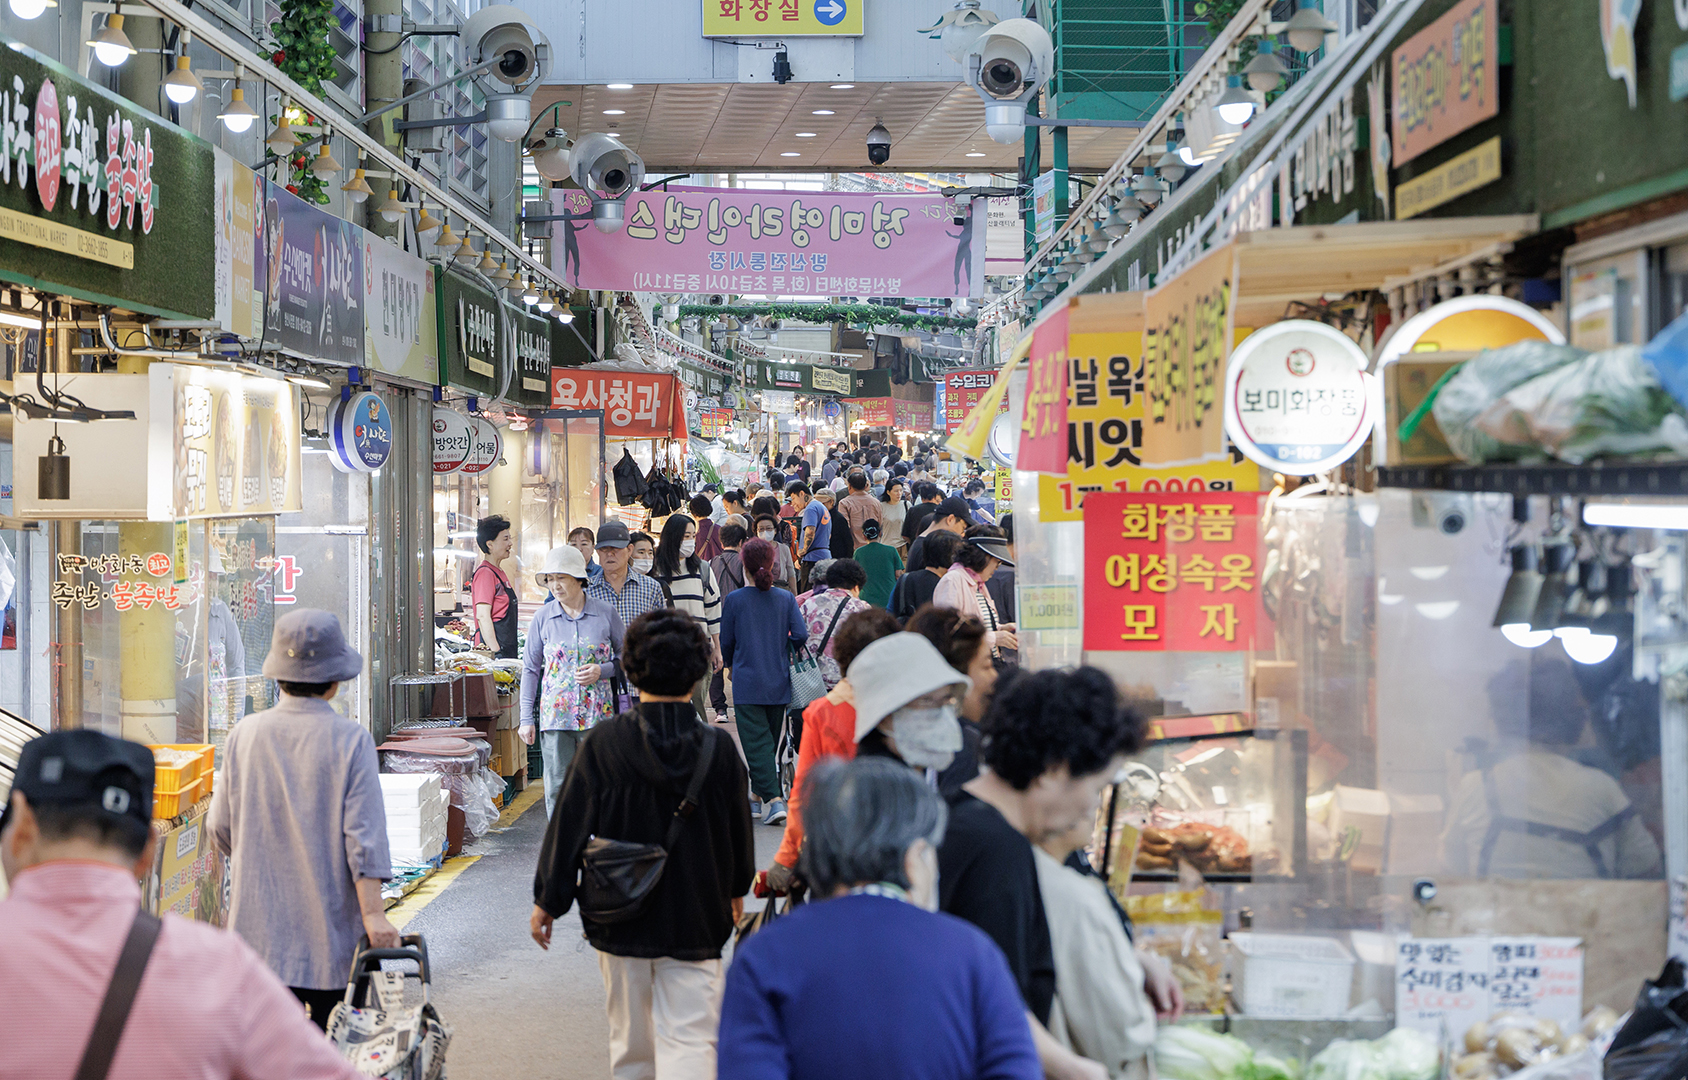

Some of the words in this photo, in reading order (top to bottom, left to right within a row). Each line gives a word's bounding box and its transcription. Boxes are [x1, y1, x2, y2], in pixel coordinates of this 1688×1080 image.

[719, 0, 800, 22] 화장실
[64, 95, 100, 216] 족발
[105, 109, 154, 235] 불족발
[50, 229, 68, 247] MARKET
[1067, 358, 1098, 407] 날
[553, 377, 661, 427] 용산청과
[1242, 389, 1357, 416] 보미화장품
[433, 436, 468, 451] 방앗간
[473, 442, 496, 455] 어물
[1278, 446, 1322, 460] D-102
[1121, 502, 1236, 542] 화장품
[90, 553, 144, 574] 방화동
[150, 559, 169, 571] 최고
[1105, 553, 1255, 593] 여성속옷
